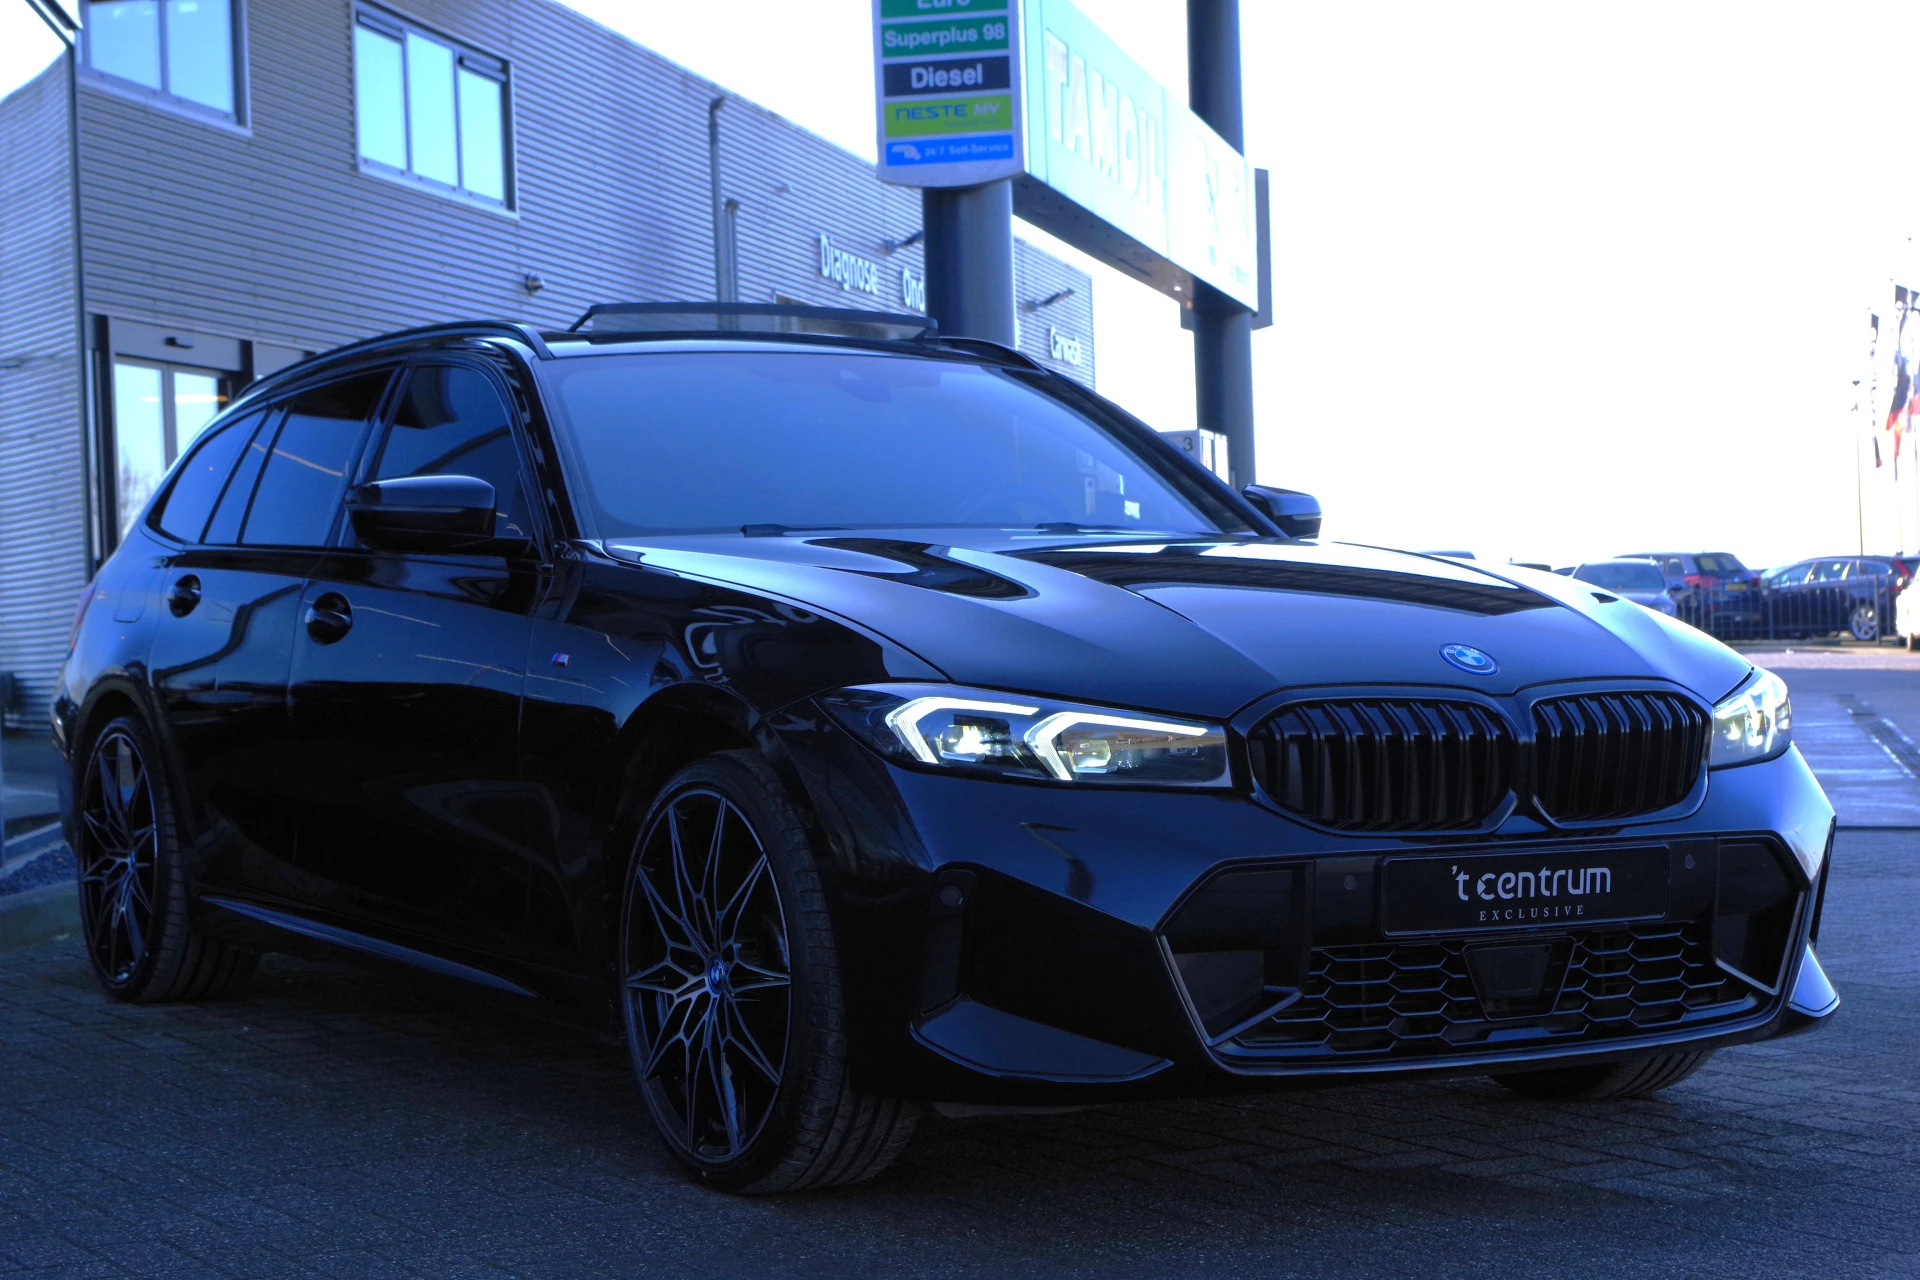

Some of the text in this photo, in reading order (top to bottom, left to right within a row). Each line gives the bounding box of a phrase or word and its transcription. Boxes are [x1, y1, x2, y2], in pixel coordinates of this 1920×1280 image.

[884, 24, 1005, 48] Superplus 98
[911, 63, 983, 89] Diesel
[1046, 28, 1166, 212] TAMOIL
[820, 235, 878, 295] Diagnose
[1050, 326, 1081, 366] Carwash
[1182, 437, 1193, 452] 3
[1476, 866, 1612, 901] centrum
[1479, 904, 1584, 921] EXCLUSIVE
